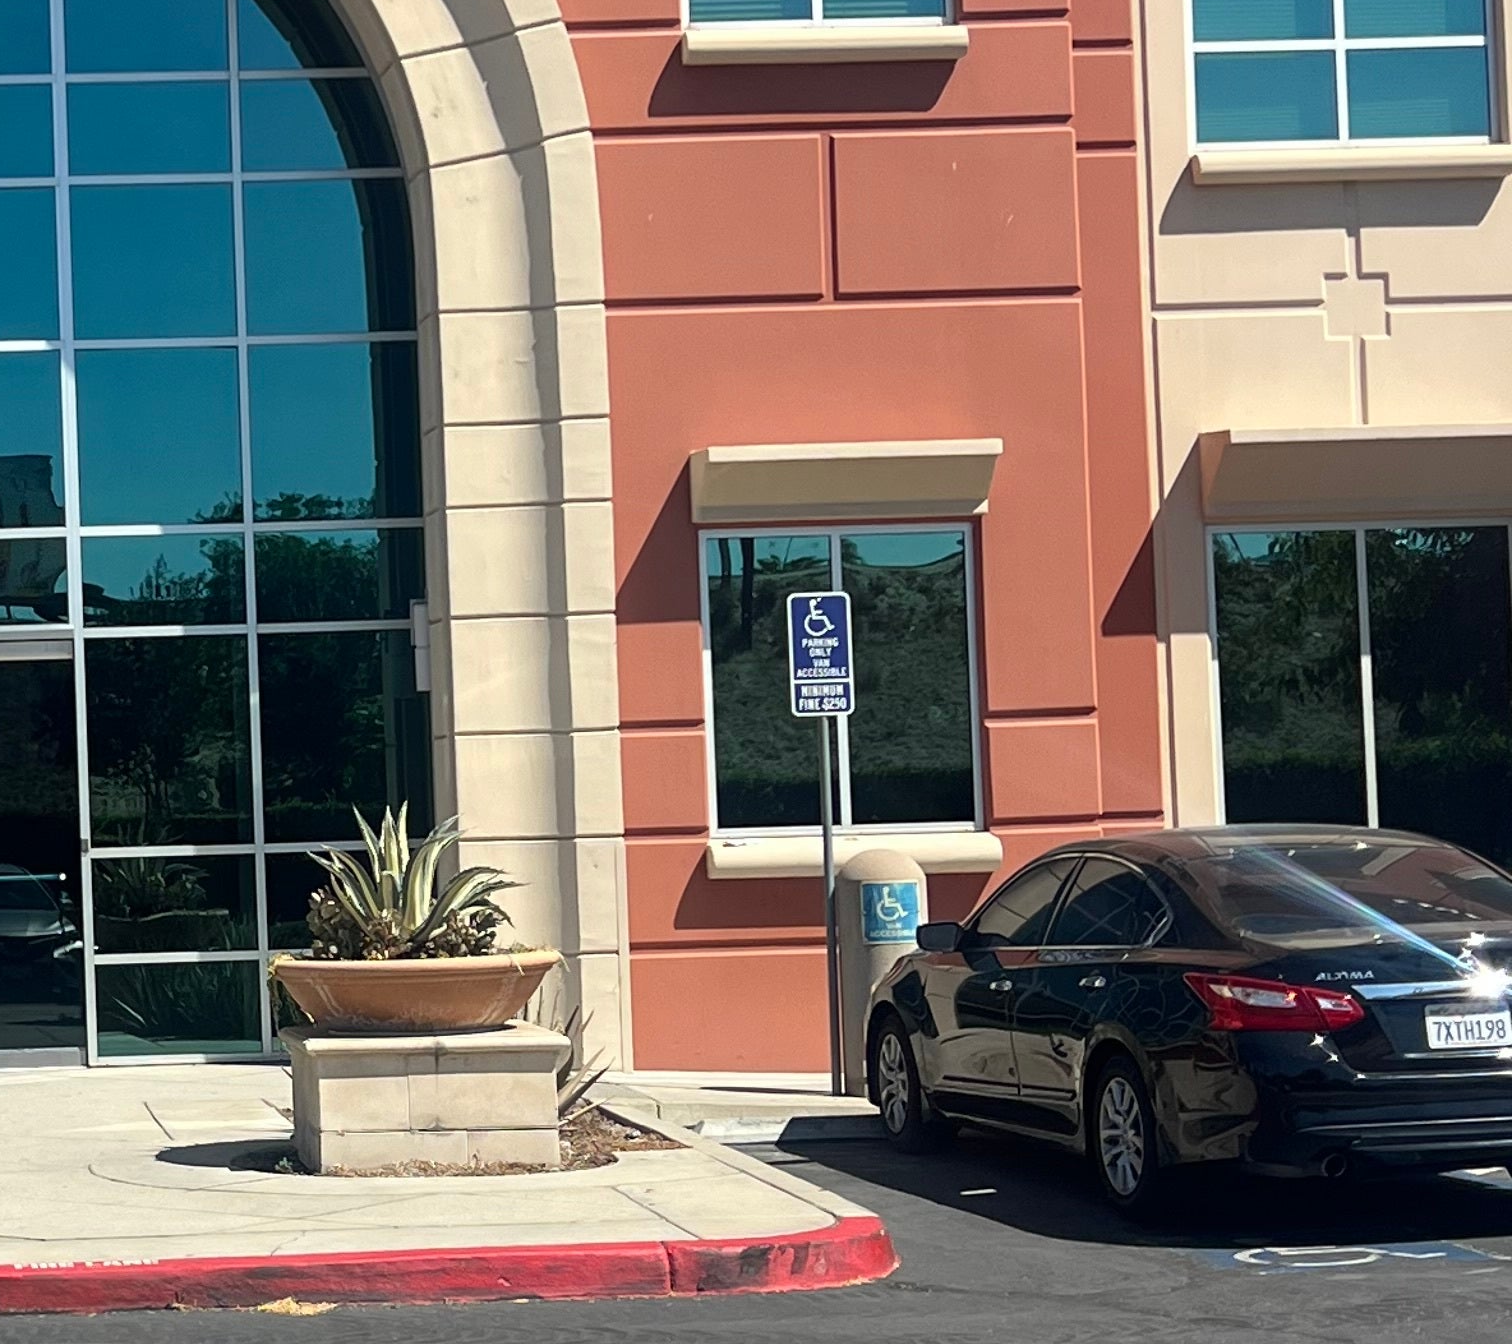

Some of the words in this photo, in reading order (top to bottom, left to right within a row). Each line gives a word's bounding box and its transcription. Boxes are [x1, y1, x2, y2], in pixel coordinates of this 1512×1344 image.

[802, 637, 839, 648] PARKING
[809, 647, 832, 657] ONLY
[812, 658, 830, 667] VAN
[797, 667, 847, 677] ACCESSIBLE
[801, 684, 844, 697] MINIMUM
[799, 697, 821, 711] FINE
[822, 697, 847, 710] $250
[1314, 970, 1375, 981] ALTIMA
[1432, 1019, 1506, 1043] 7XTH198
